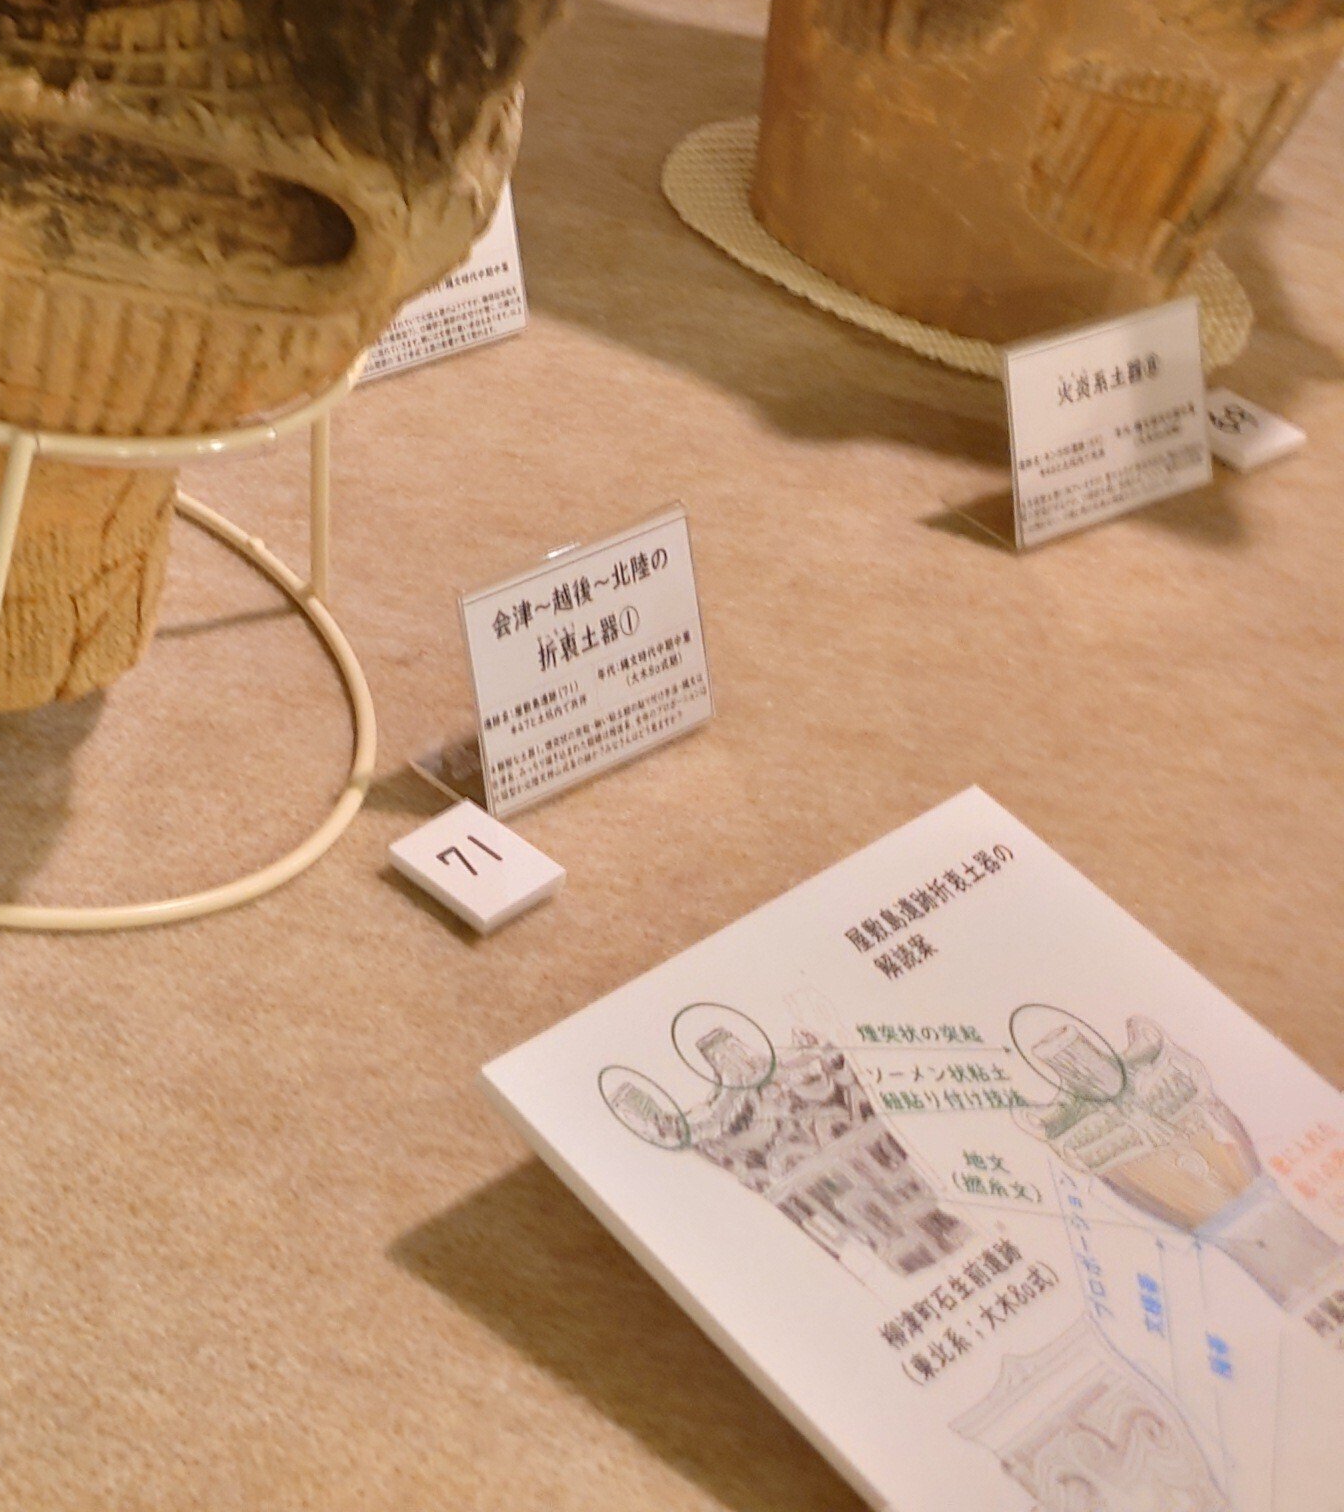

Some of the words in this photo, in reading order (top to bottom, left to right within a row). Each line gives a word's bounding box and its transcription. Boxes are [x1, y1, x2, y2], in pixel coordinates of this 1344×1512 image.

[436, 834, 503, 876] 71
[844, 844, 1014, 953] 屋敷島遺跡折衷土器の
[873, 934, 939, 980] 解読案
